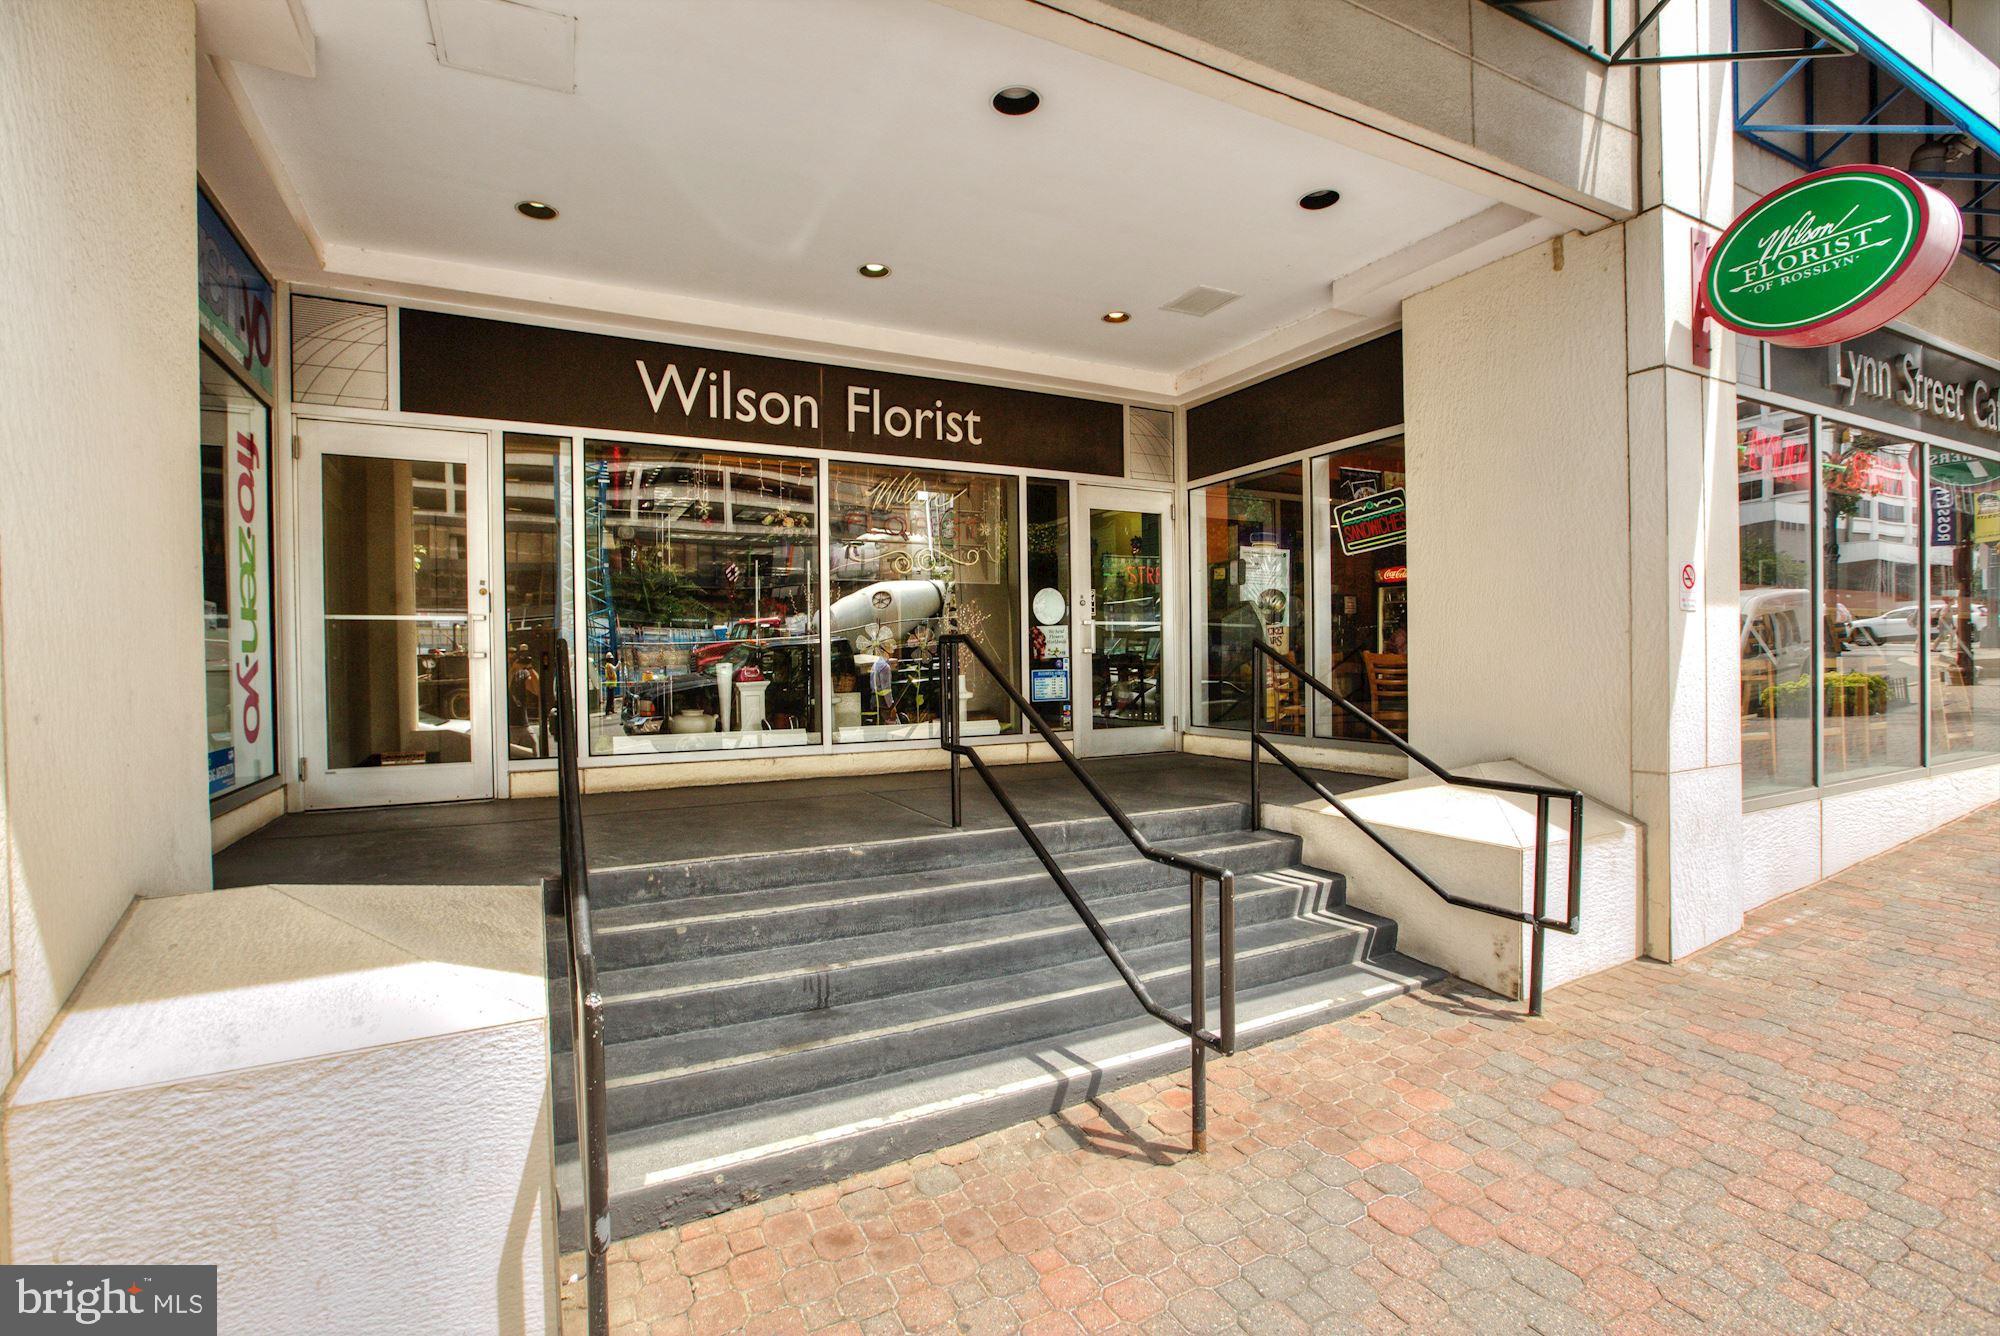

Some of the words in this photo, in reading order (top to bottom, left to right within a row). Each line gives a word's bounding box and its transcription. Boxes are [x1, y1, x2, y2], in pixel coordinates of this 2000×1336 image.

[1743, 228, 1872, 284] FLORIST
[1758, 204, 1860, 264] Wilson
[635, 360, 819, 429] Wilson
[847, 385, 983, 446] Florist
[1836, 343, 1892, 406] Lynn
[1903, 352, 1965, 421] Street
[1972, 379, 2000, 432] Ca
